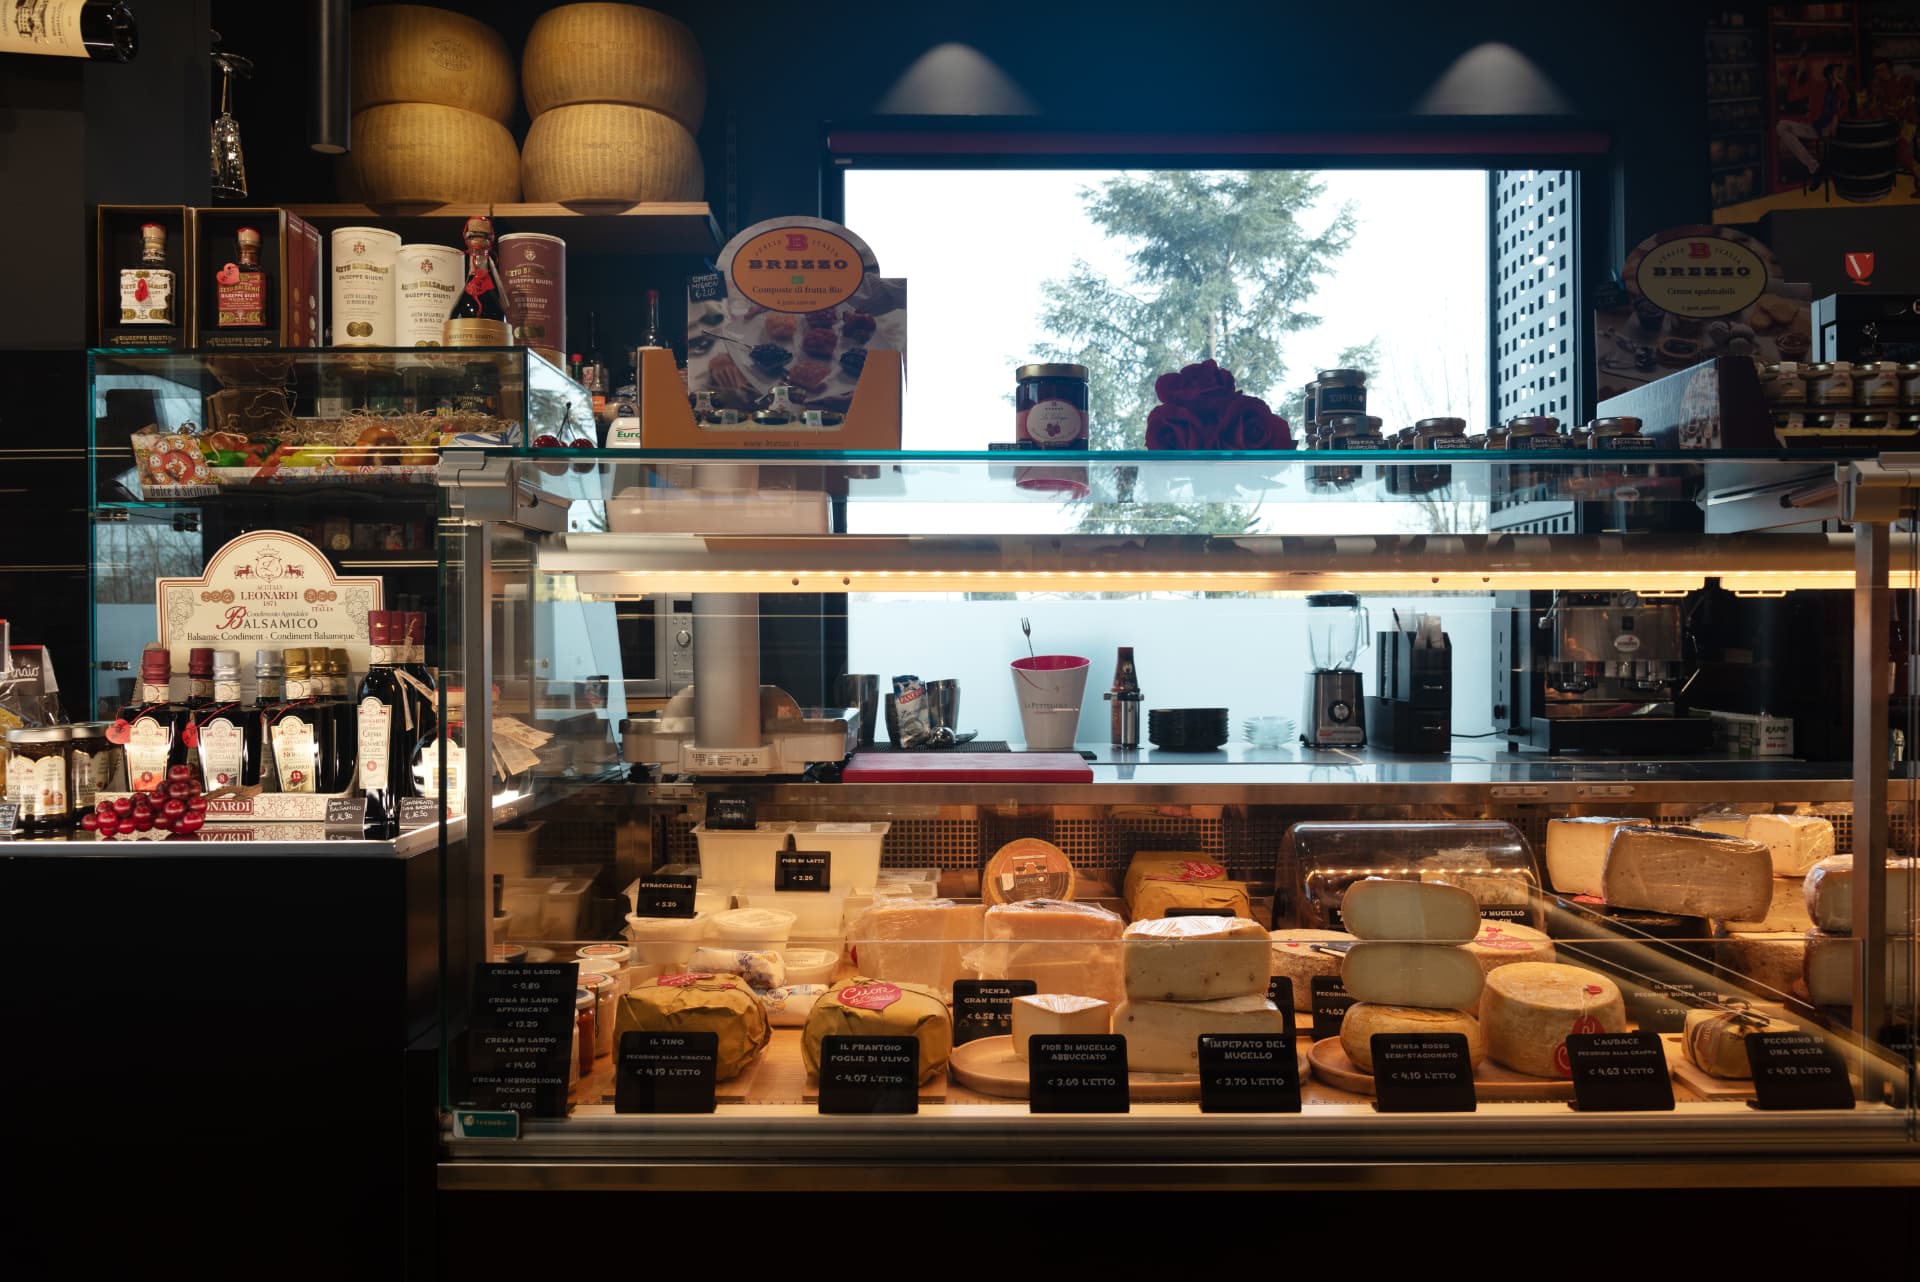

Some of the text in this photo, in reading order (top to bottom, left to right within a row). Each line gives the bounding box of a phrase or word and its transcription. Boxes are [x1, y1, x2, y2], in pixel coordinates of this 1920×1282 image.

[749, 259, 849, 270] BREZZO
[1653, 266, 1751, 276] BREZZO
[419, 281, 455, 292] BALSAMICO
[752, 286, 792, 295] Composte
[794, 286, 802, 295] di
[805, 286, 827, 295] frutta
[1666, 287, 1735, 297] Creme spalmabili
[240, 591, 298, 601] LEONARDI
[187, 632, 355, 641] Balsamic Condiment Condiment Balsamique
[206, 801, 250, 811] ONARDI
[650, 1038, 685, 1046] IL TINO
[1593, 1038, 1640, 1046] L'AUDACE
[840, 1043, 902, 1051] IL FRANTOIO
[1224, 1052, 1273, 1060] MUGELLO
[1769, 1048, 1823, 1056] UNA VOLTA
[831, 1055, 910, 1063] FOGLIE DI ULIVO
[1051, 1053, 1107, 1061] ABBUCCIATO
[669, 1068, 701, 1076] L'ETTO
[1623, 1067, 1655, 1076] L'ETTO
[1800, 1067, 1831, 1075] L'ETTO
[870, 1074, 903, 1083] L'ETTO
[1424, 1072, 1456, 1080] L'ETTO
[1082, 1078, 1116, 1087] L'ETTO
[1250, 1077, 1285, 1086] L'ETTO
